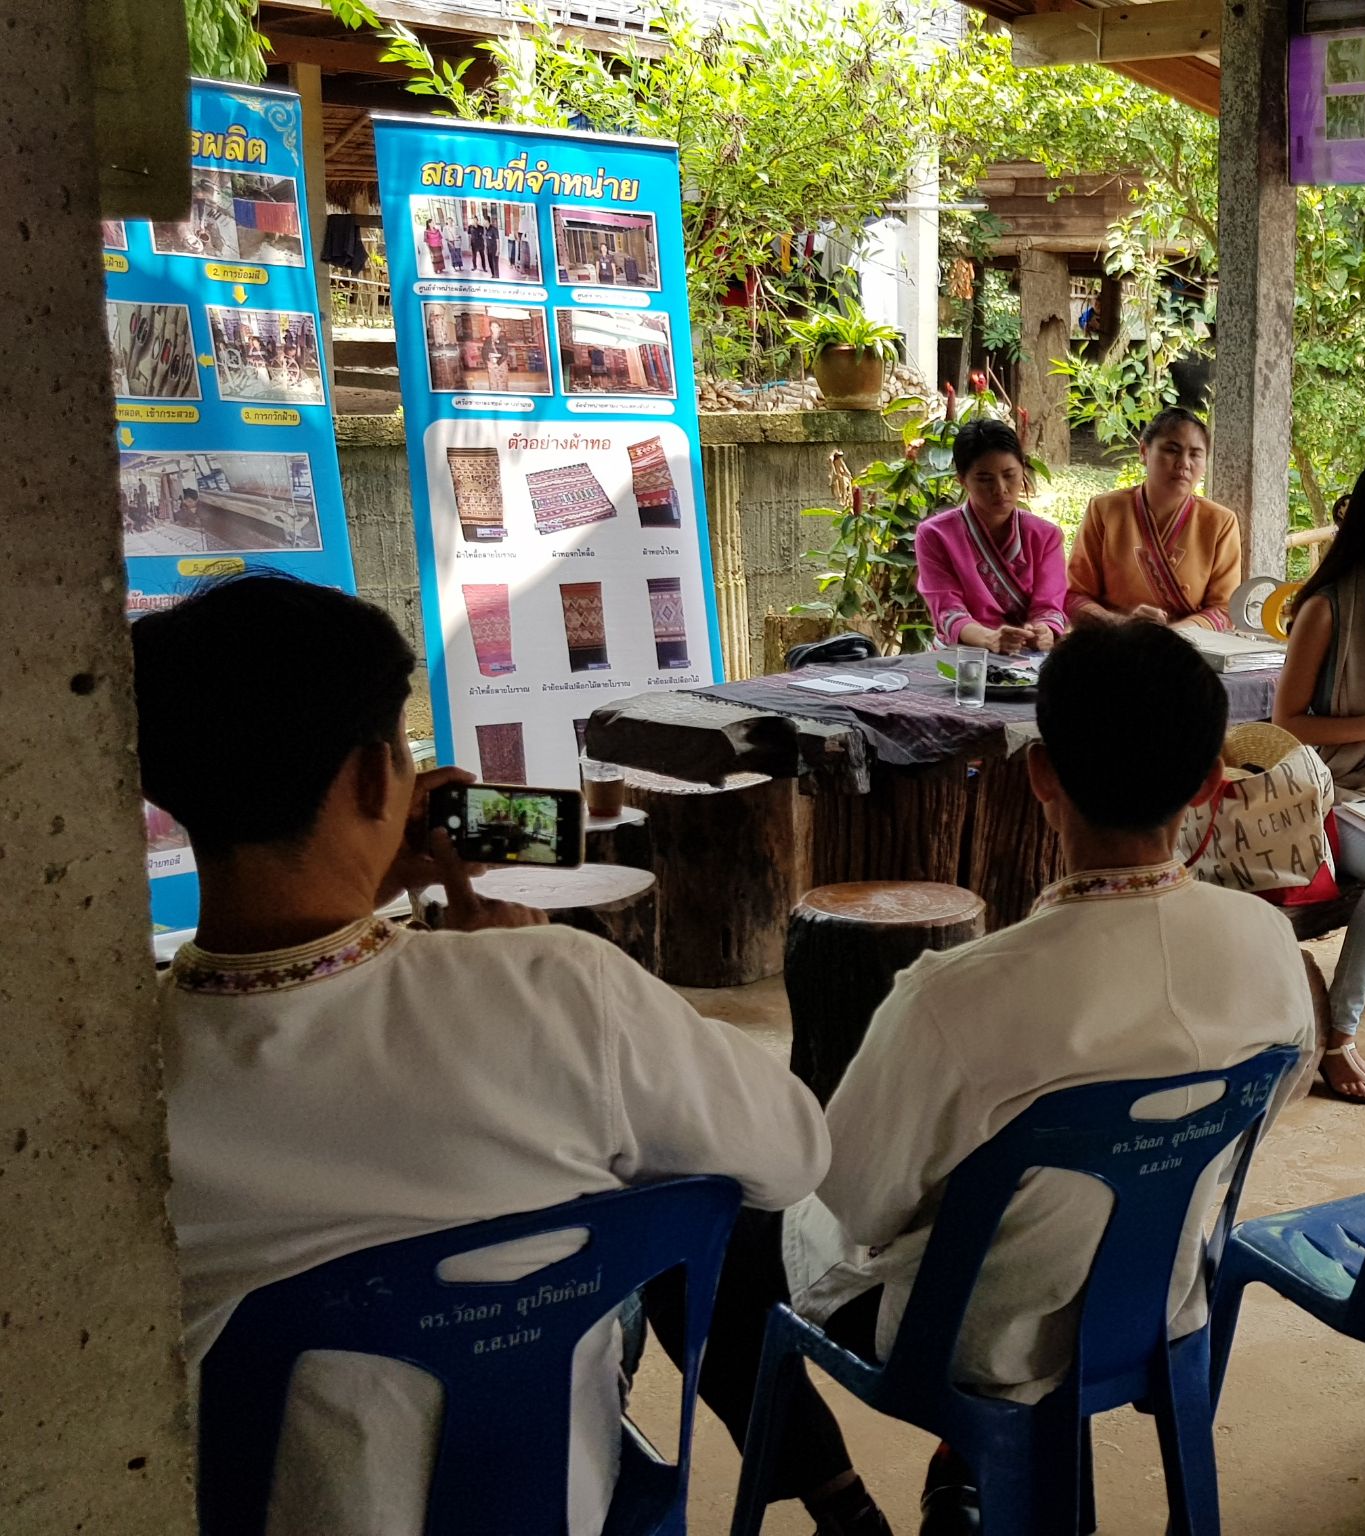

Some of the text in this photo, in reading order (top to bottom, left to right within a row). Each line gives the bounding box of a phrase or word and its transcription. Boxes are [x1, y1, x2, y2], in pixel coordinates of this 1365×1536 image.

[421, 152, 639, 201] สถานที่จำหน่าย
[223, 269, 261, 279] การย้อมสี
[146, 407, 195, 418] เข้ากระสวย
[508, 432, 611, 450] ตัวอย่างผ้าทอ
[469, 684, 530, 695] ผ้าไทลื้อลายโบราณ
[1139, 1154, 1183, 1176] ส.ส.น่าน
[473, 1326, 541, 1355] ส.ส.น่าน
